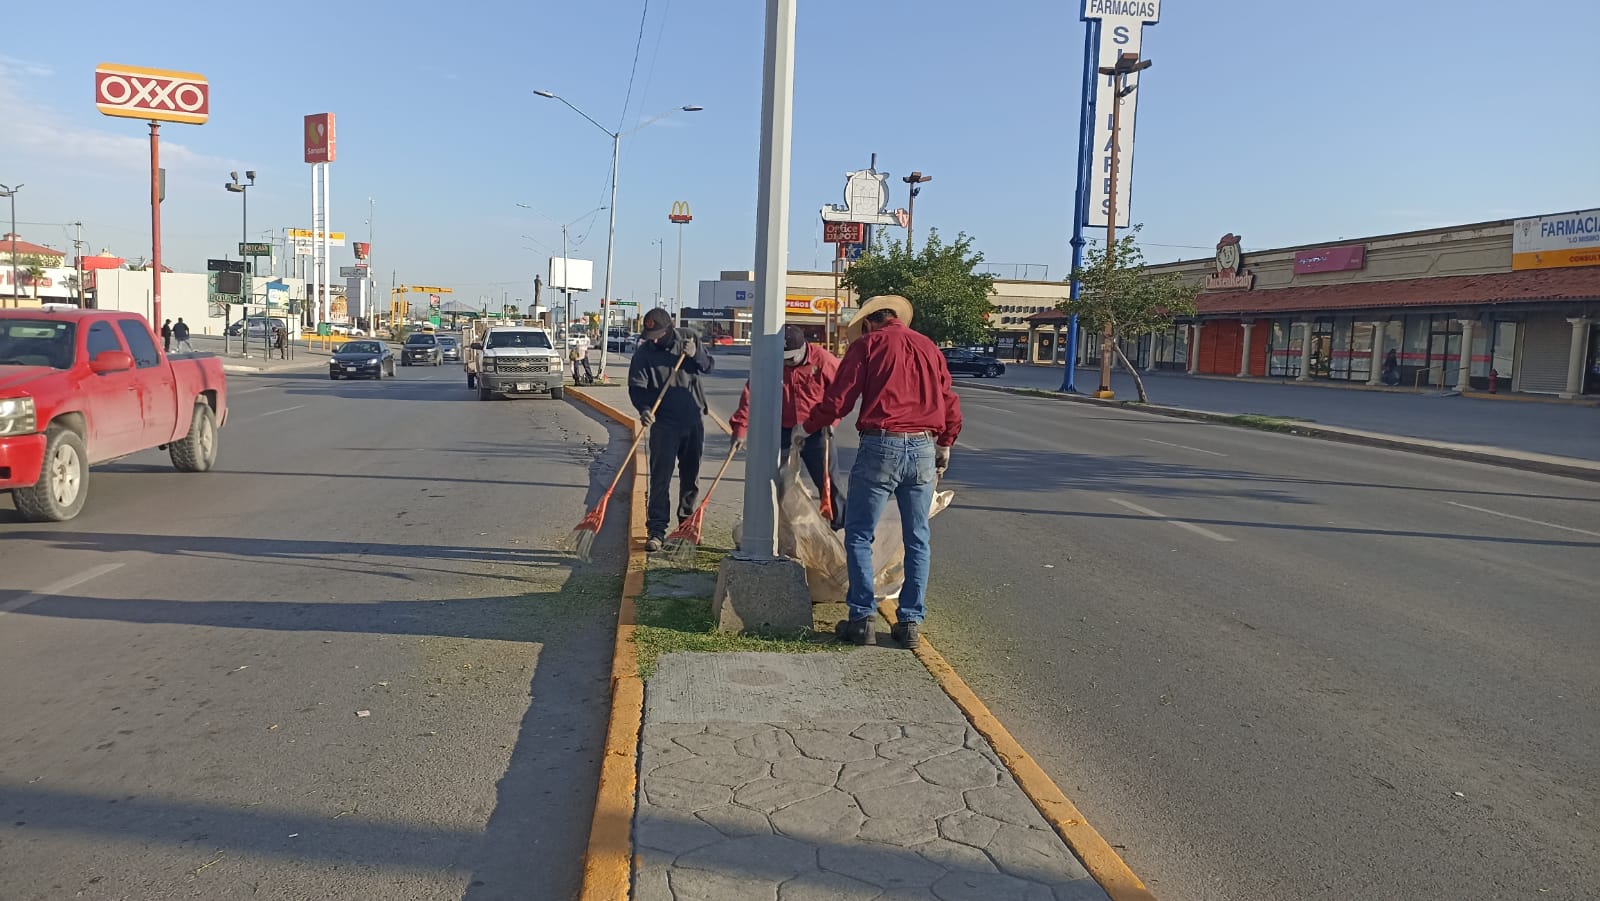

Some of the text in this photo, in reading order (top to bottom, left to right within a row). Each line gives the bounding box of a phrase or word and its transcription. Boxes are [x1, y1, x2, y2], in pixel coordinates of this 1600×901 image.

[1091, 0, 1155, 17] FARMACIAS
[100, 75, 204, 111] OXXO
[1101, 26, 1130, 216] SIMLARES
[1541, 217, 1600, 238] FARMACI
[786, 300, 809, 308] PEÑOS
